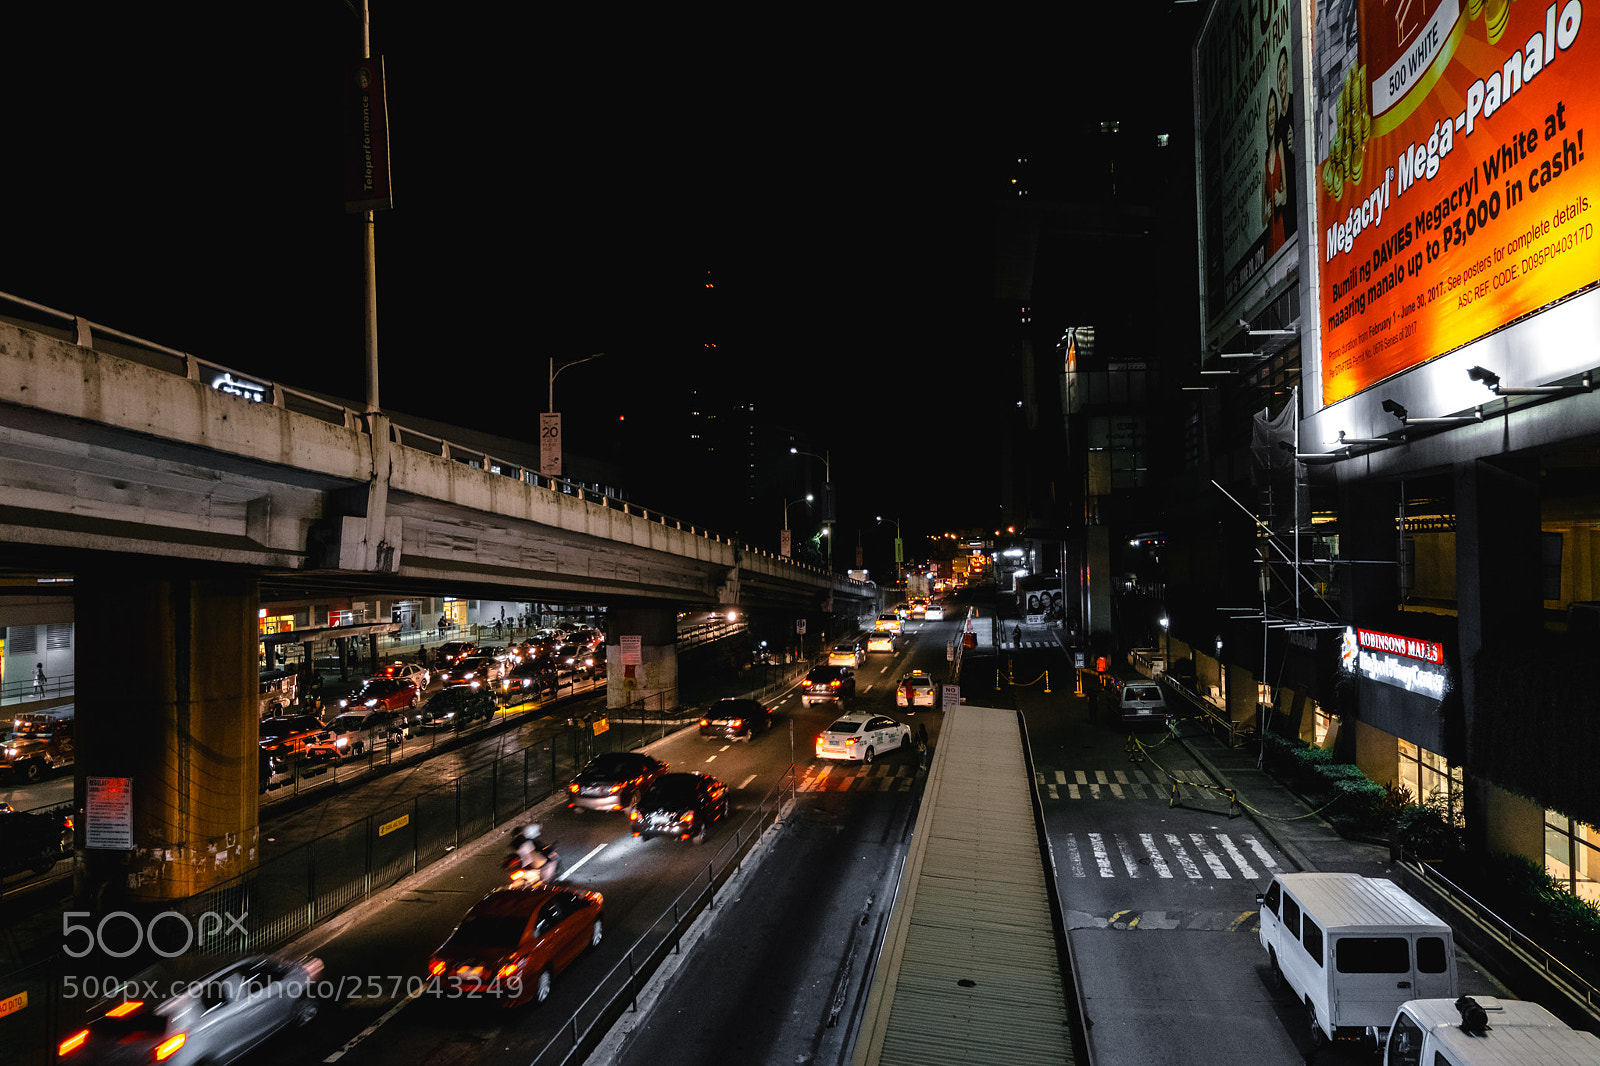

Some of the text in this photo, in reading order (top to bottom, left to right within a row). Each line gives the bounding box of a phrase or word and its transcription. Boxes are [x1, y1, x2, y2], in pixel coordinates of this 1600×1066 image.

[1249, 31, 1270, 95] BUDDY
[1272, 0, 1289, 53] RUN
[1389, 20, 1439, 97] 500 WHITE
[1397, 0, 1583, 198] Mega-Panalo
[362, 95, 373, 191] Teleperformance
[1328, 129, 1585, 333] maaaring manalo up to P3,000 in cash!
[1332, 101, 1566, 303] Bumili ng DAVIES Megacryl White at
[1358, 330, 1368, 345] from
[1368, 315, 1393, 338] February
[1401, 302, 1416, 319] June
[1417, 293, 1427, 309] 30,
[1428, 282, 1446, 303] 2017.
[1447, 275, 1462, 291] See
[1463, 256, 1492, 286] posters
[1494, 248, 1505, 265] for
[1507, 219, 1550, 256] complete
[1552, 196, 1592, 228] details.
[1458, 291, 1473, 310] ASC
[1474, 280, 1492, 301] REF.
[1492, 264, 1520, 290] CODE:
[1405, 321, 1417, 338] 2017
[542, 426, 558, 438] 20
[1359, 631, 1438, 662] ROBINSONS MALLS
[8, 996, 22, 1010] DITO
